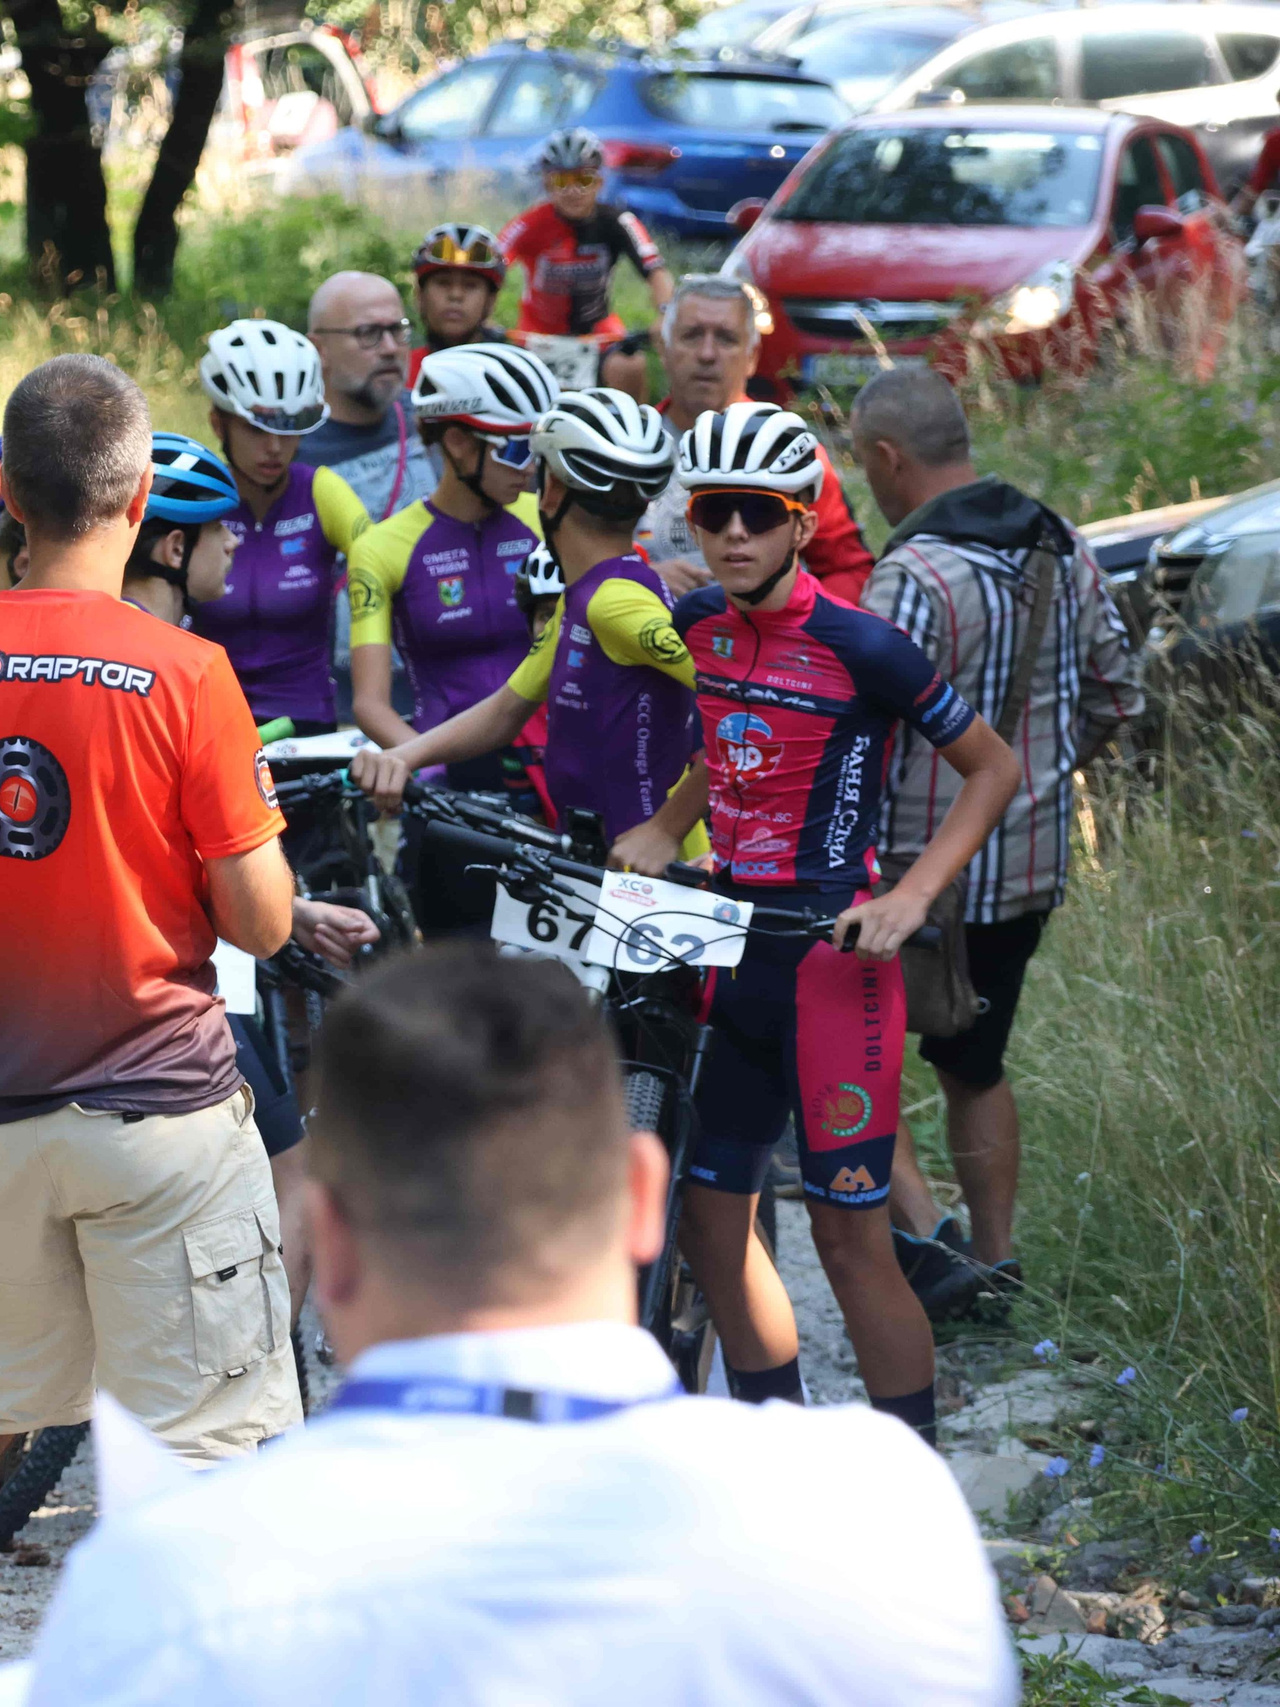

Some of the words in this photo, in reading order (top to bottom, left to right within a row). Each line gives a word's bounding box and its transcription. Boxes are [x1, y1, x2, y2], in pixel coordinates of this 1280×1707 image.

[634, 727, 650, 775] Omega
[640, 777, 654, 816] Team
[527, 903, 596, 951] 67
